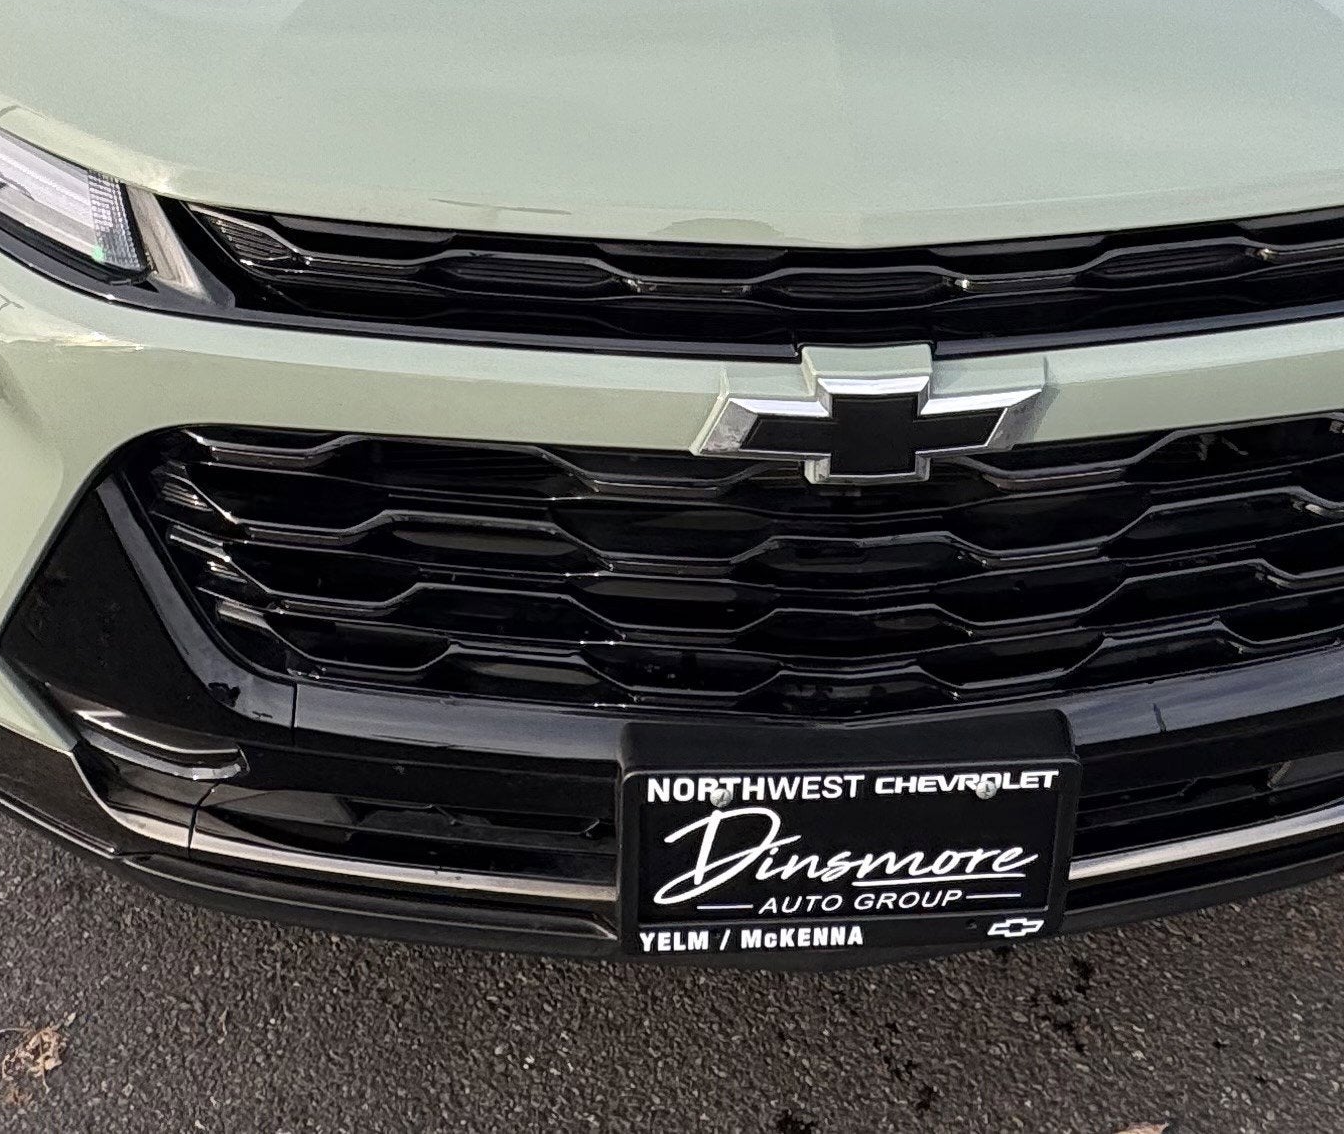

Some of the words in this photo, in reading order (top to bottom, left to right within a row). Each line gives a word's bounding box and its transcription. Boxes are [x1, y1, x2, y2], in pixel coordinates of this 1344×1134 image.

[647, 774, 865, 803] NORTHWEST
[654, 807, 1039, 905] Dinsmore
[758, 893, 843, 915] AUTO
[853, 889, 964, 911] GROUP
[639, 929, 709, 952] YELM
[740, 926, 864, 949] McKENNA
